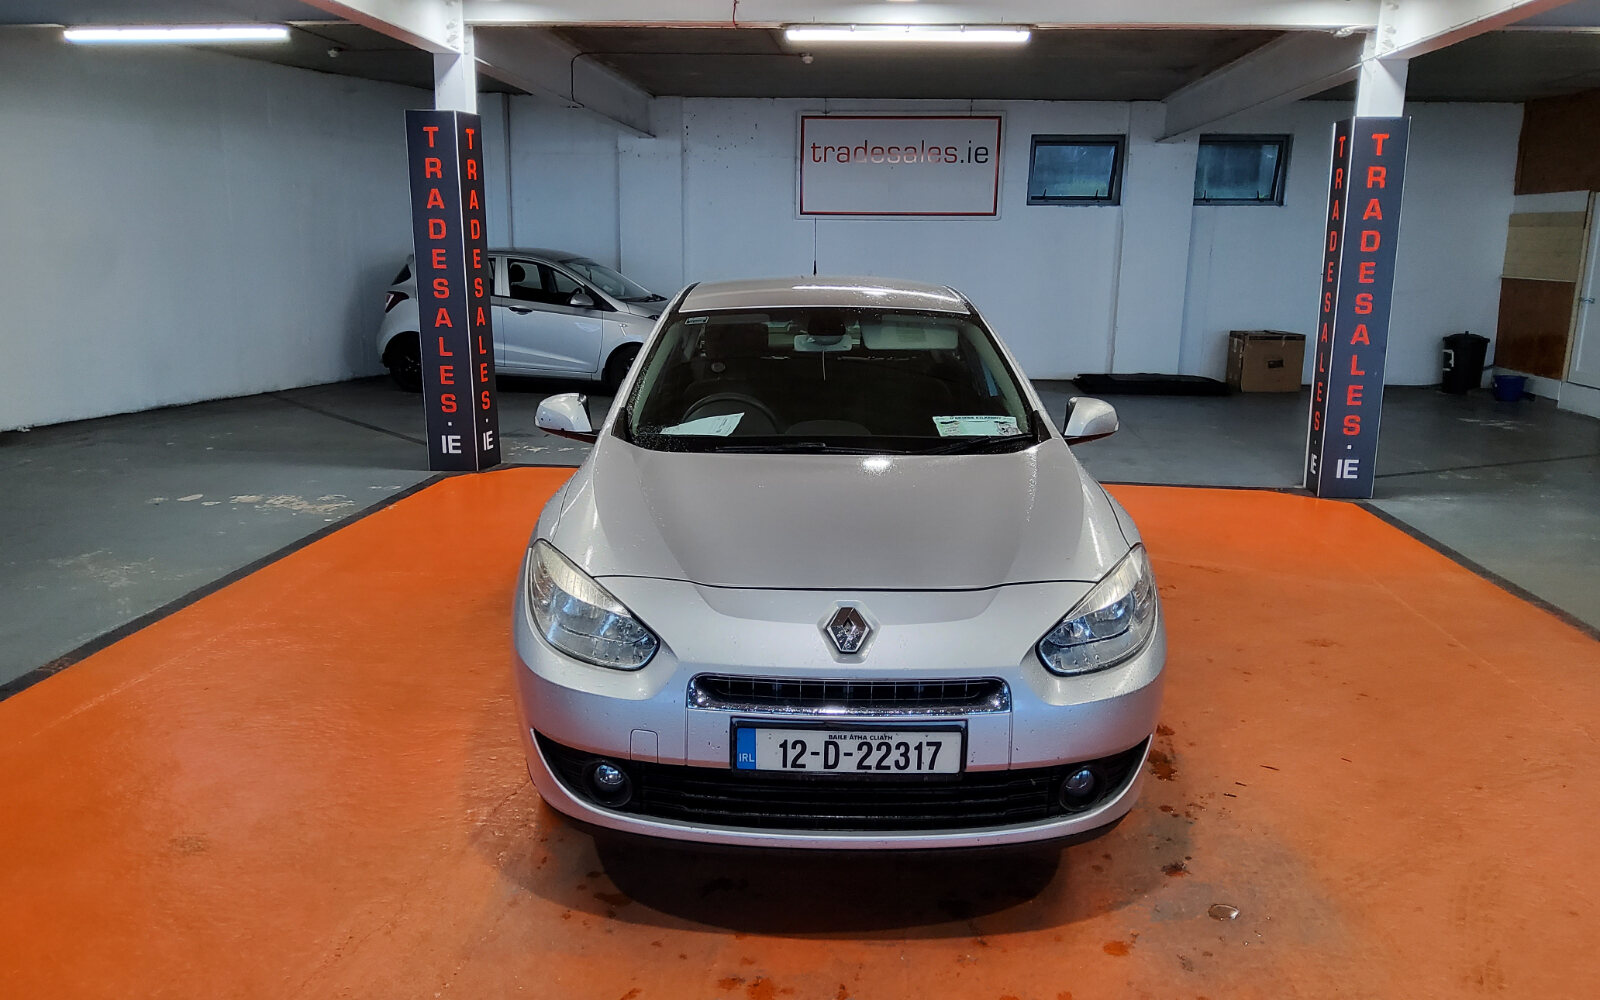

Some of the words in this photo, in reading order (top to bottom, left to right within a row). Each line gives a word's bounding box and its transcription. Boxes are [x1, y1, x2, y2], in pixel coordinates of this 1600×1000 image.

[811, 139, 989, 164] tradesales.ie
[869, 734, 893, 742] CLIATH
[738, 752, 755, 762] IRL
[778, 738, 943, 771] 12-D-22317
